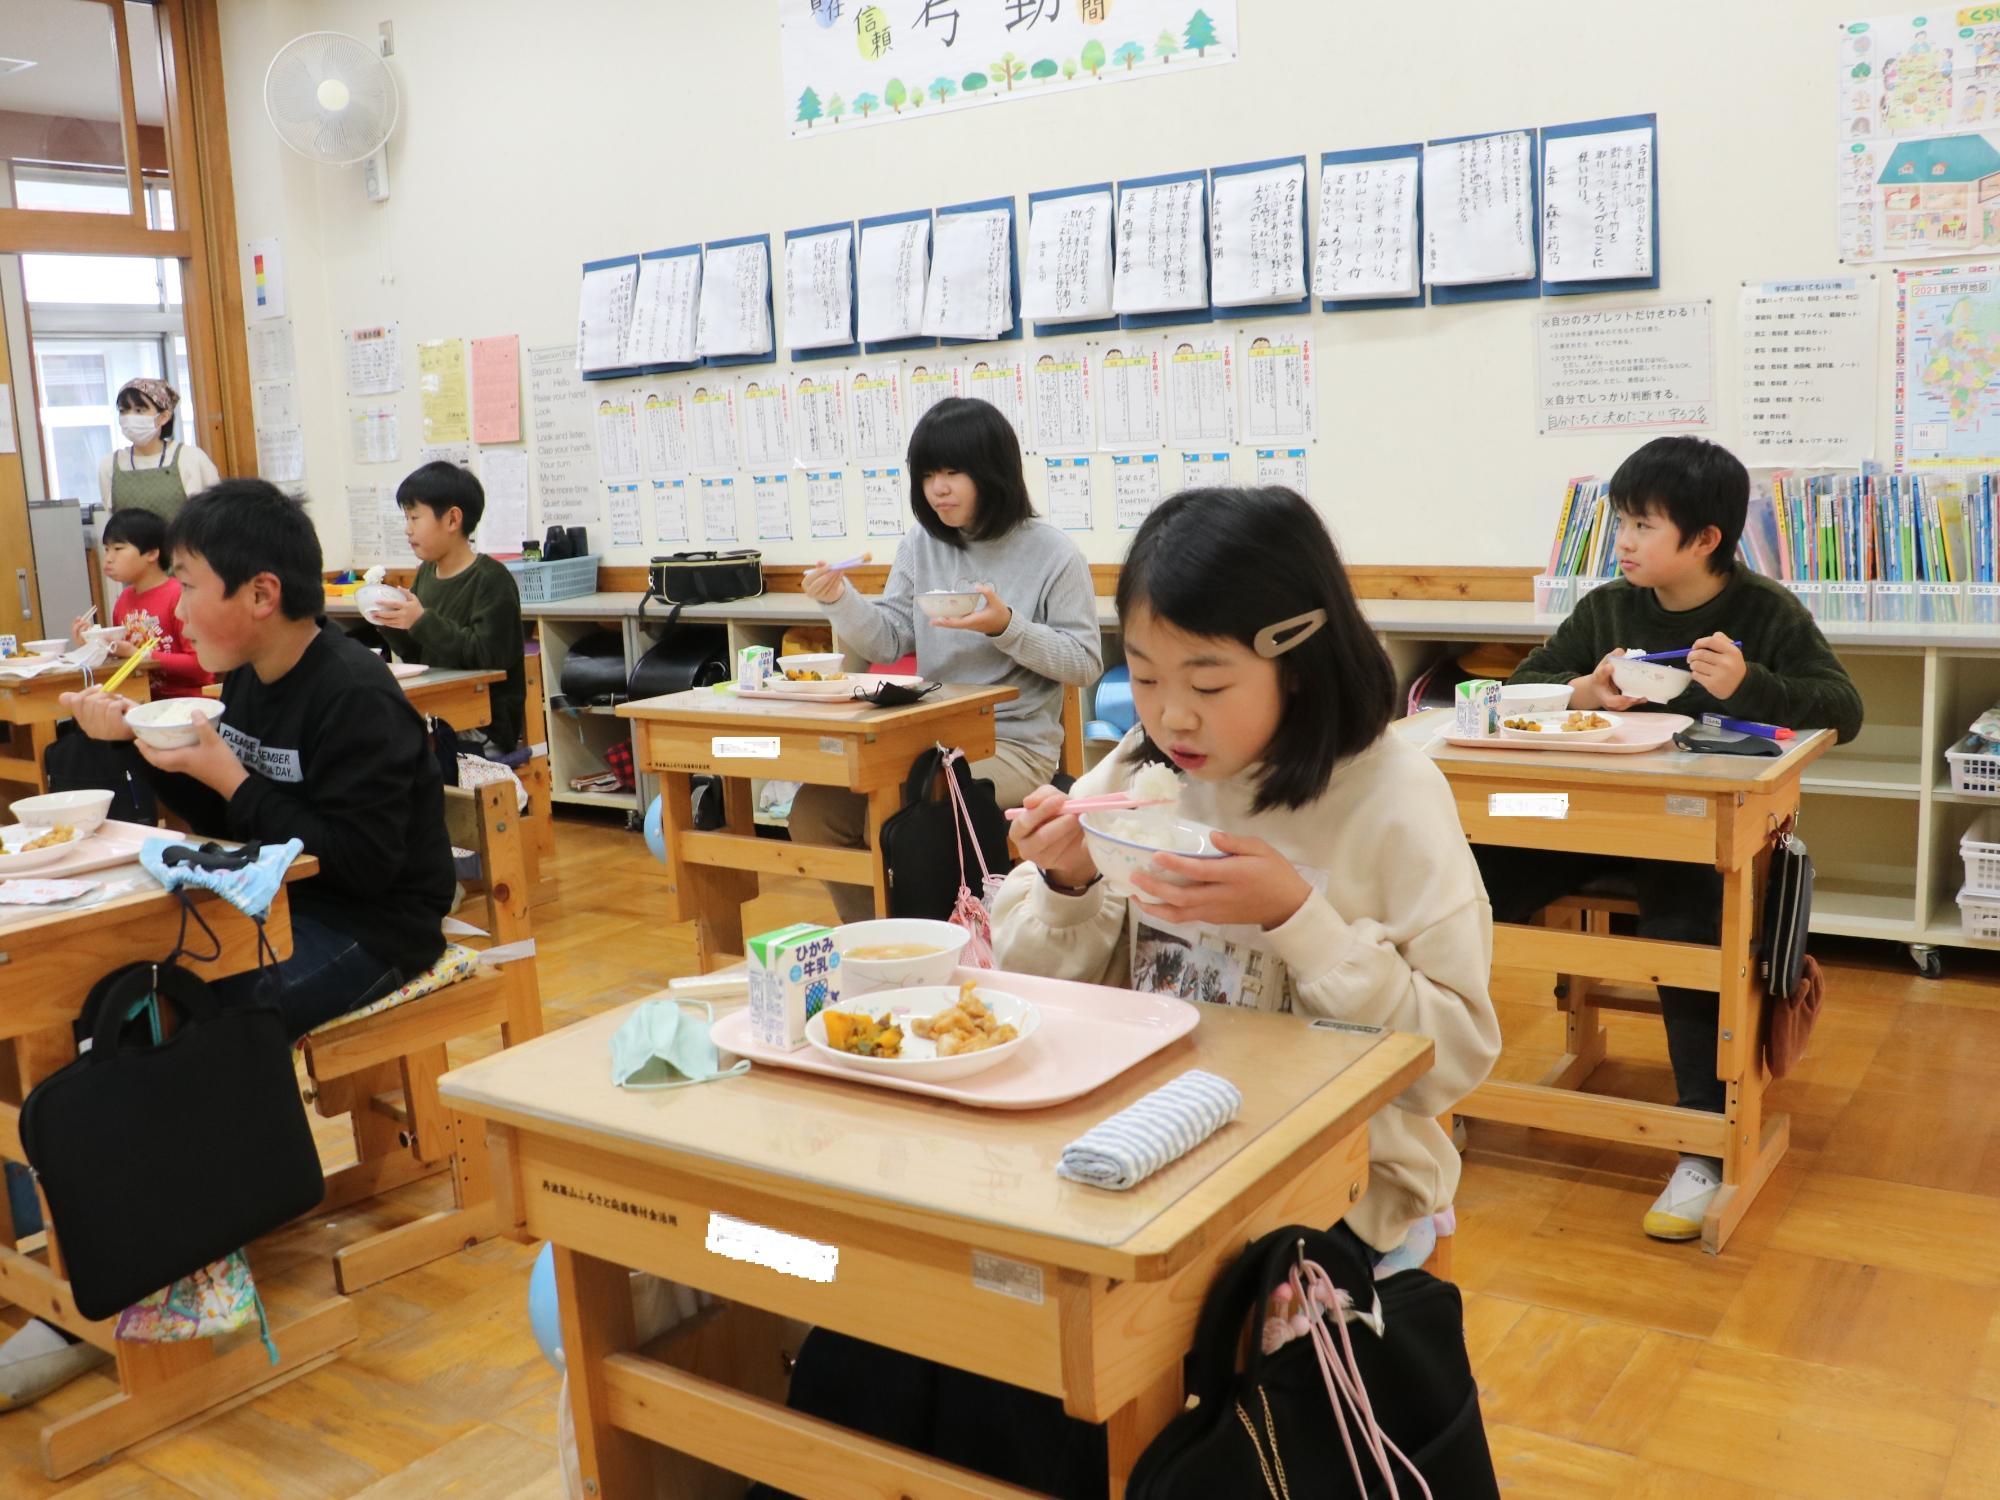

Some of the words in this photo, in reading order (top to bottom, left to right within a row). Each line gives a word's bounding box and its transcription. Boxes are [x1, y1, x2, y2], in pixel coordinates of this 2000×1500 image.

[853, 7, 894, 58] 信頼
[1914, 284, 1938, 296] 2021
[1940, 280, 1989, 294] 新世界地図
[531, 367, 552, 377] Stand
[552, 366, 562, 376] up
[553, 378, 570, 388] Hello
[567, 389, 587, 400] hand
[535, 406, 551, 417] Look
[537, 431, 552, 442] Look
[554, 431, 568, 441] and
[540, 459, 555, 469] Your
[556, 459, 572, 468] turn
[551, 472, 566, 481] turn
[222, 729, 256, 751] PLEASE
[795, 937, 835, 962] ひかみ
[803, 956, 829, 977] 牛乳
